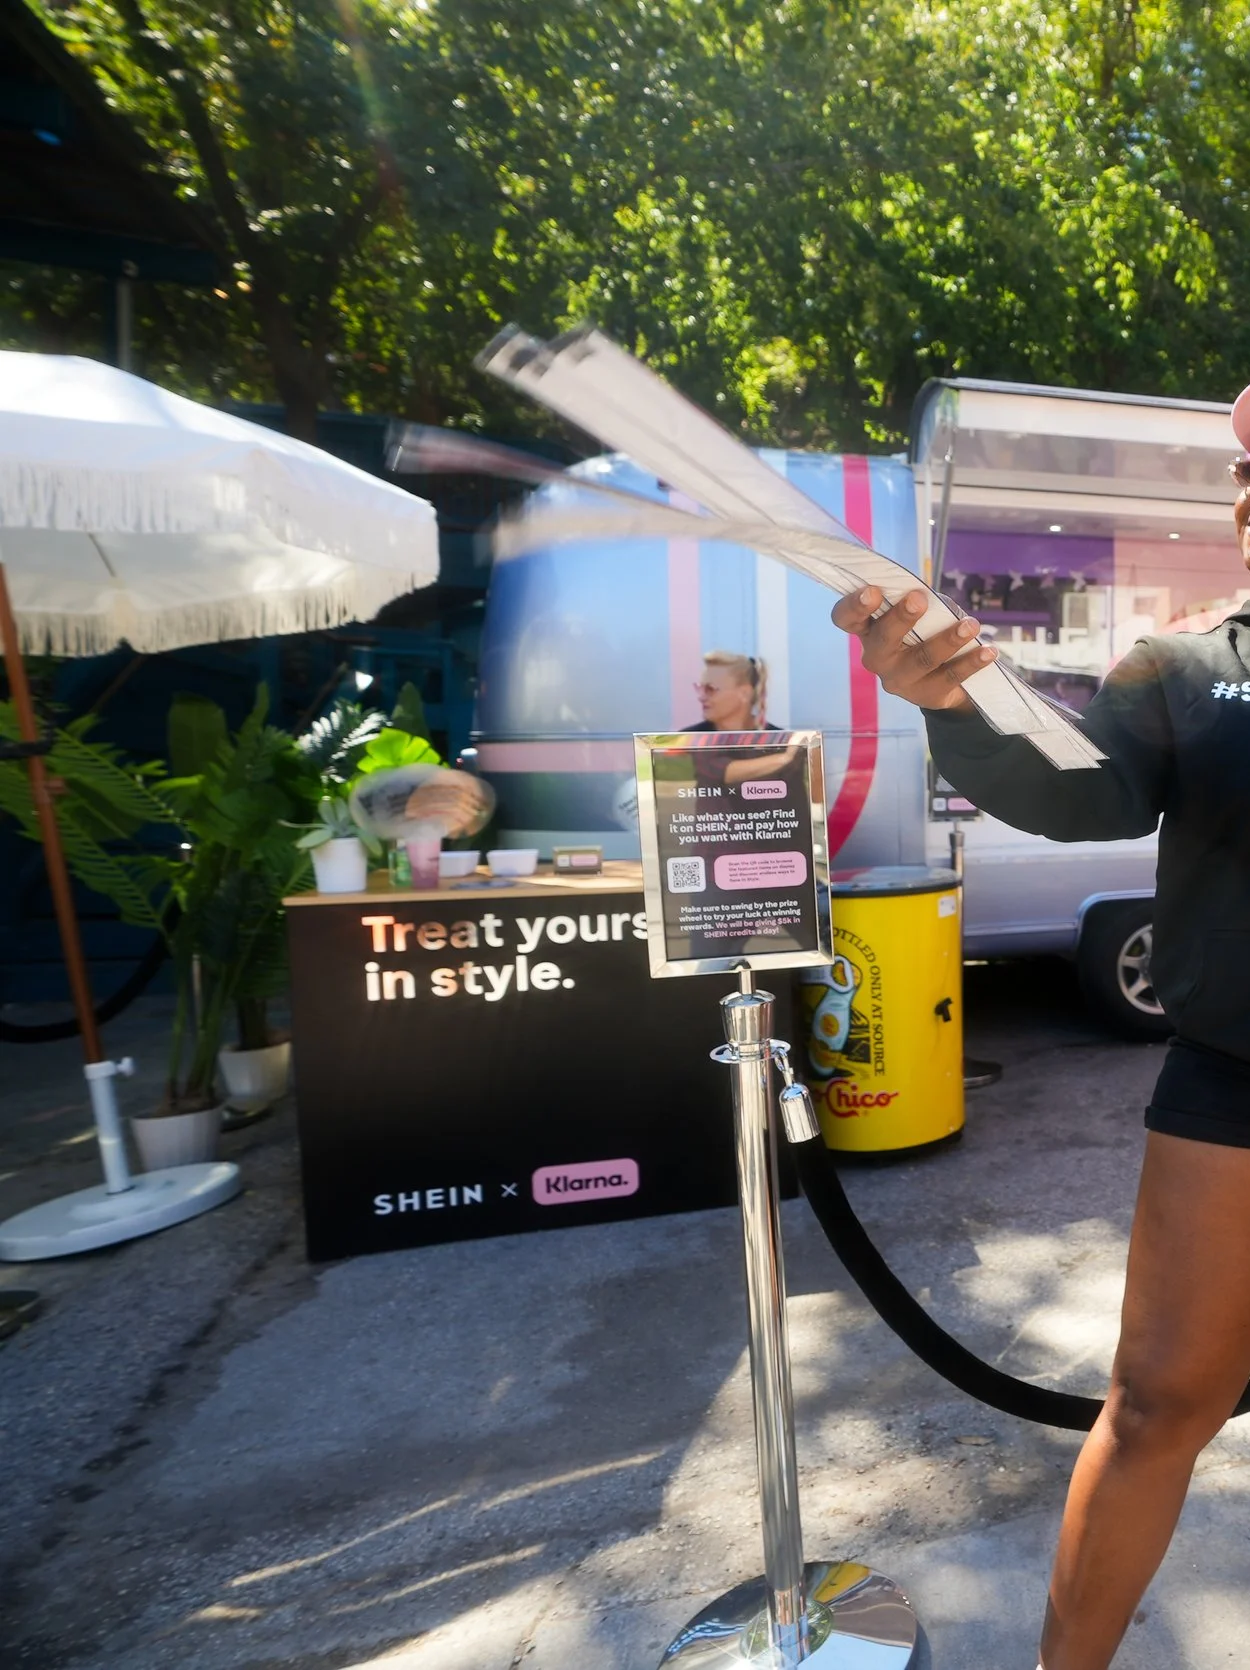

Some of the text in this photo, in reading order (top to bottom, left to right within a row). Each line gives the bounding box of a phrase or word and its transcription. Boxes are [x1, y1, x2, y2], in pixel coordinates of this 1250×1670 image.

[678, 787, 722, 798] SHEIN
[672, 809, 795, 823] Like what you see? Find
[669, 824, 678, 833] it
[680, 825, 694, 833] on
[734, 821, 754, 830] and
[755, 822, 775, 831] pay
[777, 820, 799, 828] how
[679, 830, 791, 845] you want with Klarna!
[680, 906, 701, 914] Make
[731, 903, 753, 911] swing
[754, 902, 764, 910] by
[779, 899, 798, 908] prize
[679, 914, 702, 923] wheel
[713, 913, 725, 921] try
[726, 912, 744, 921] your
[745, 910, 761, 918] luck
[772, 908, 801, 916] winning
[754, 918, 777, 927] giving
[361, 911, 650, 954] Treat yours
[729, 929, 756, 937] credits
[364, 954, 576, 1001] in style.
[833, 927, 885, 1076] OTTLED ONLY AT SOURCE
[825, 1077, 899, 1118] Chico
[374, 1184, 483, 1216] SHEIN
[545, 1172, 629, 1194] Klarna.
